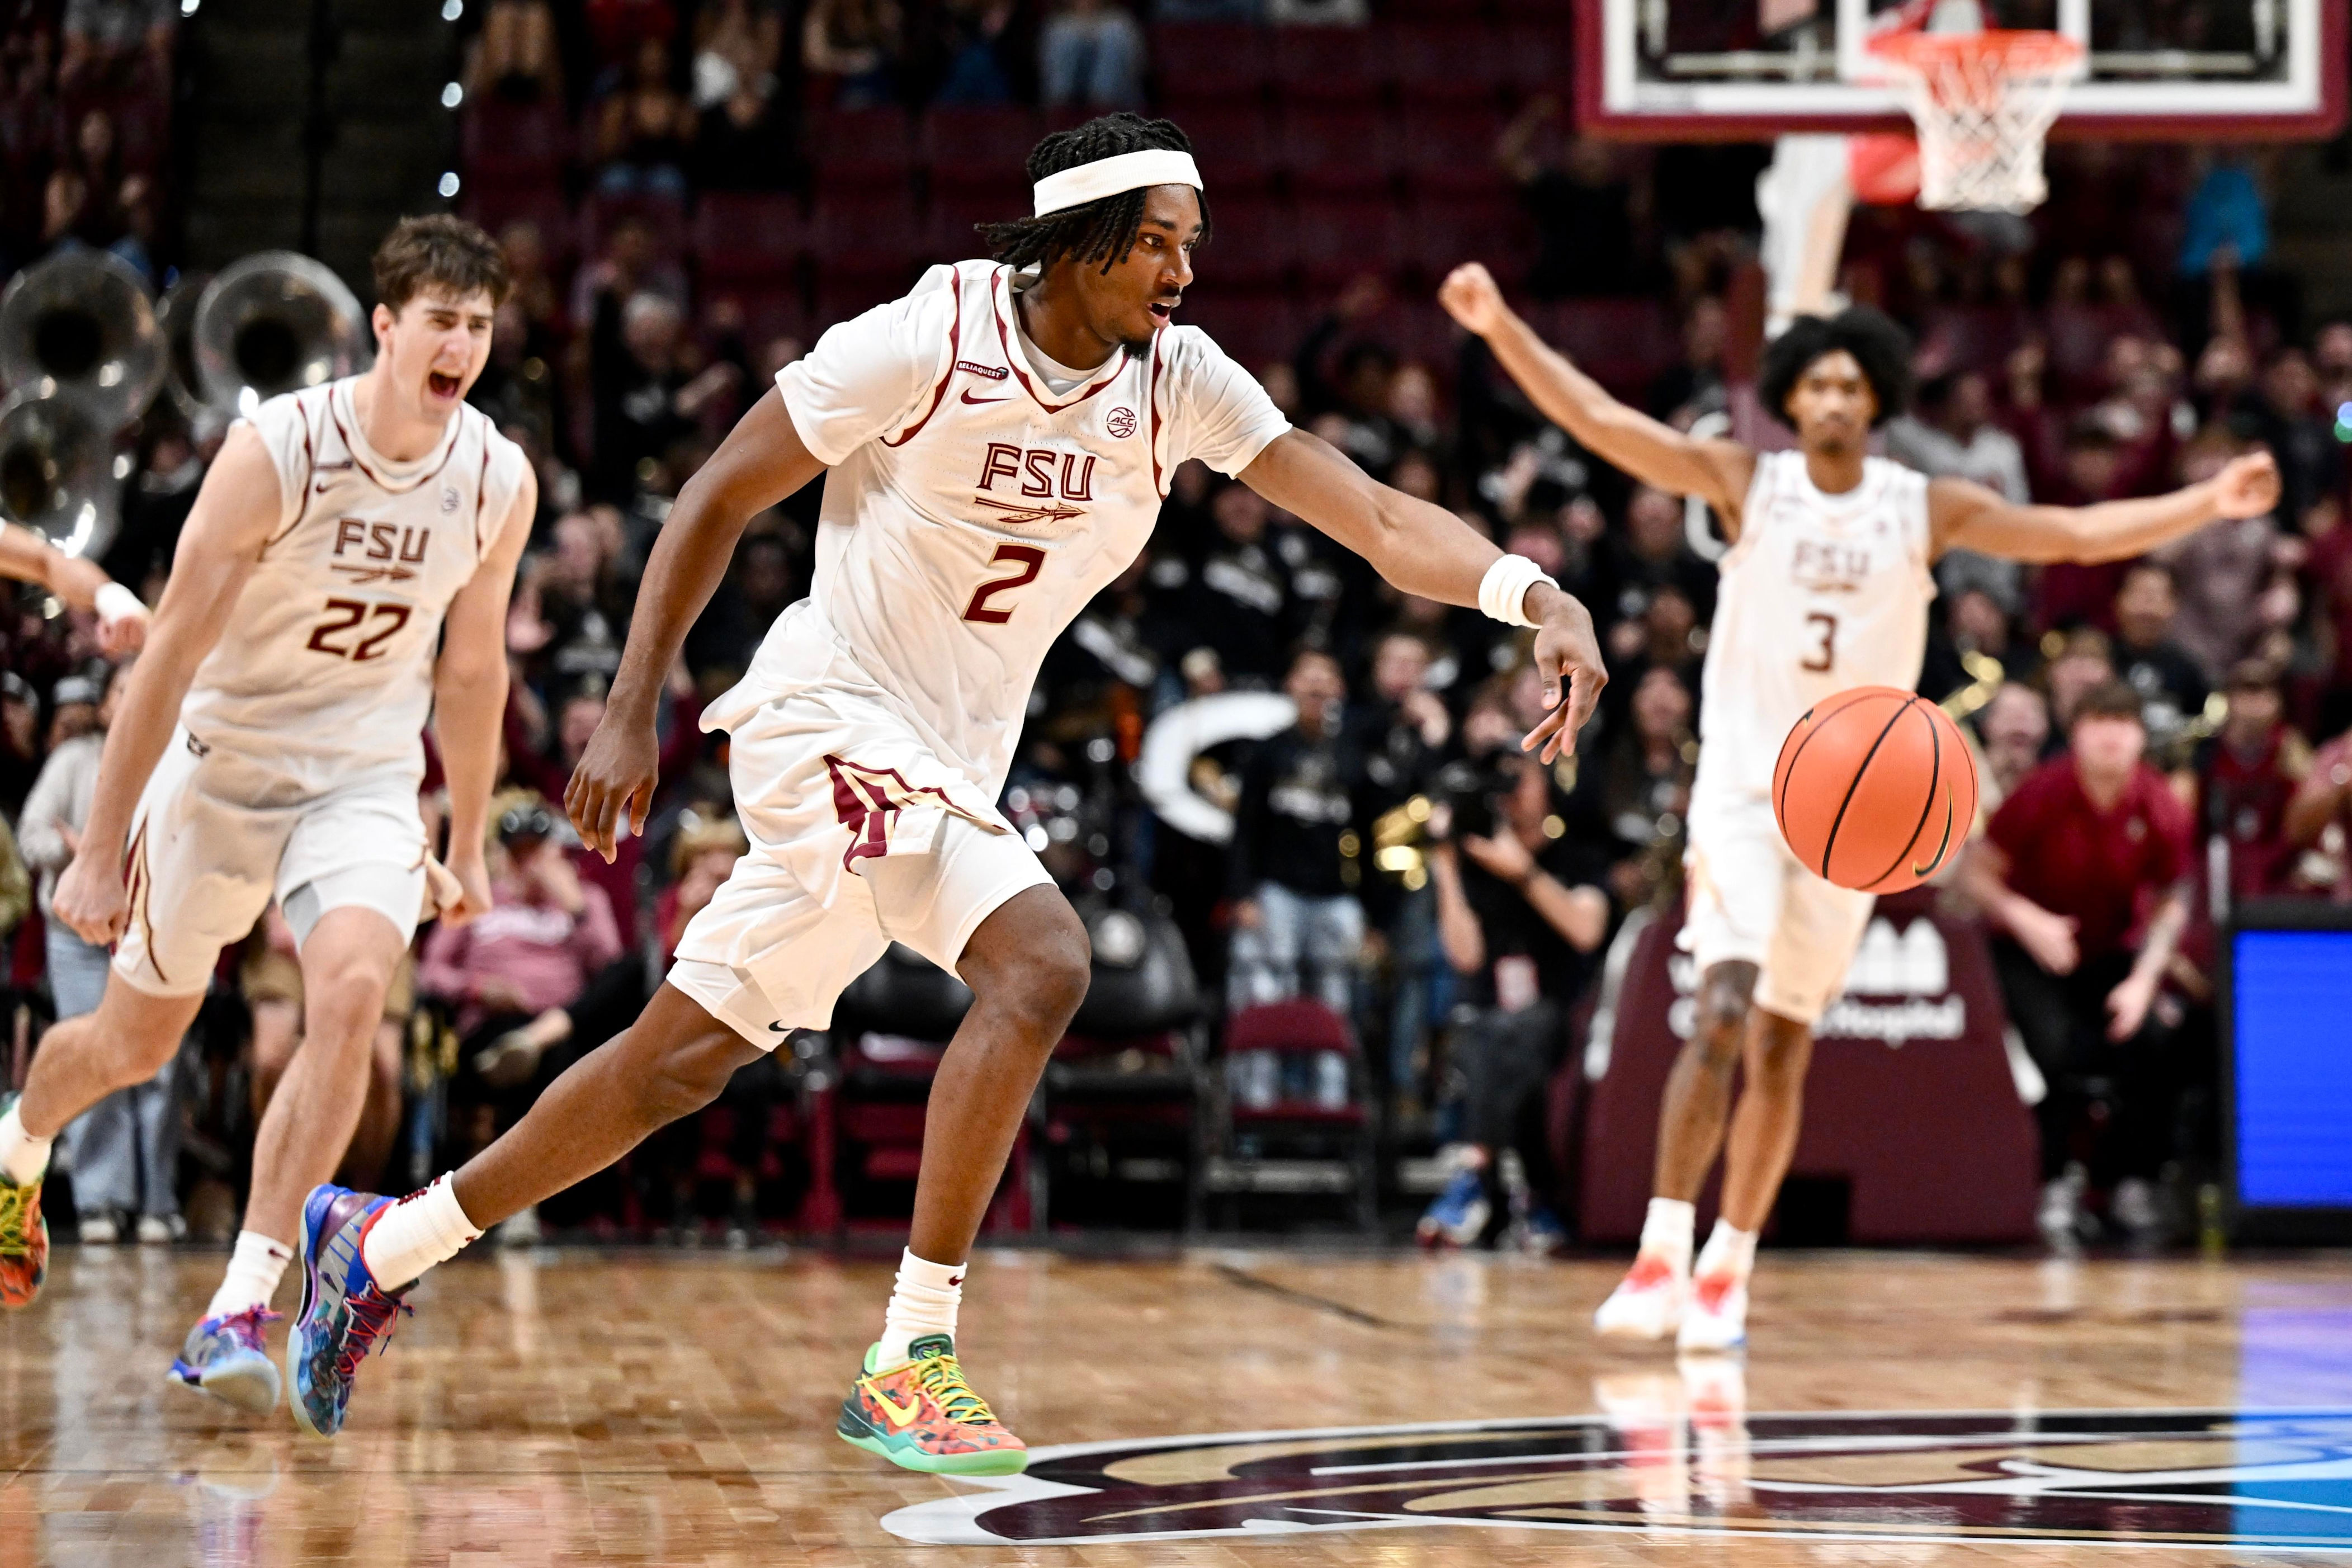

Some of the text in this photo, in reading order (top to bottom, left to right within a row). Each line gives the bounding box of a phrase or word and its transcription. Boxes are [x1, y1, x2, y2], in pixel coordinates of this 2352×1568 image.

[958, 362, 1001, 379] RELIAQUEST
[1110, 417, 1136, 426] ACC
[976, 442, 1096, 501] FSU
[334, 517, 430, 563] FSU
[1792, 539, 1870, 577] FSU
[960, 541, 1048, 626] 2
[306, 597, 413, 662] 22
[1800, 612, 1838, 673] 3
